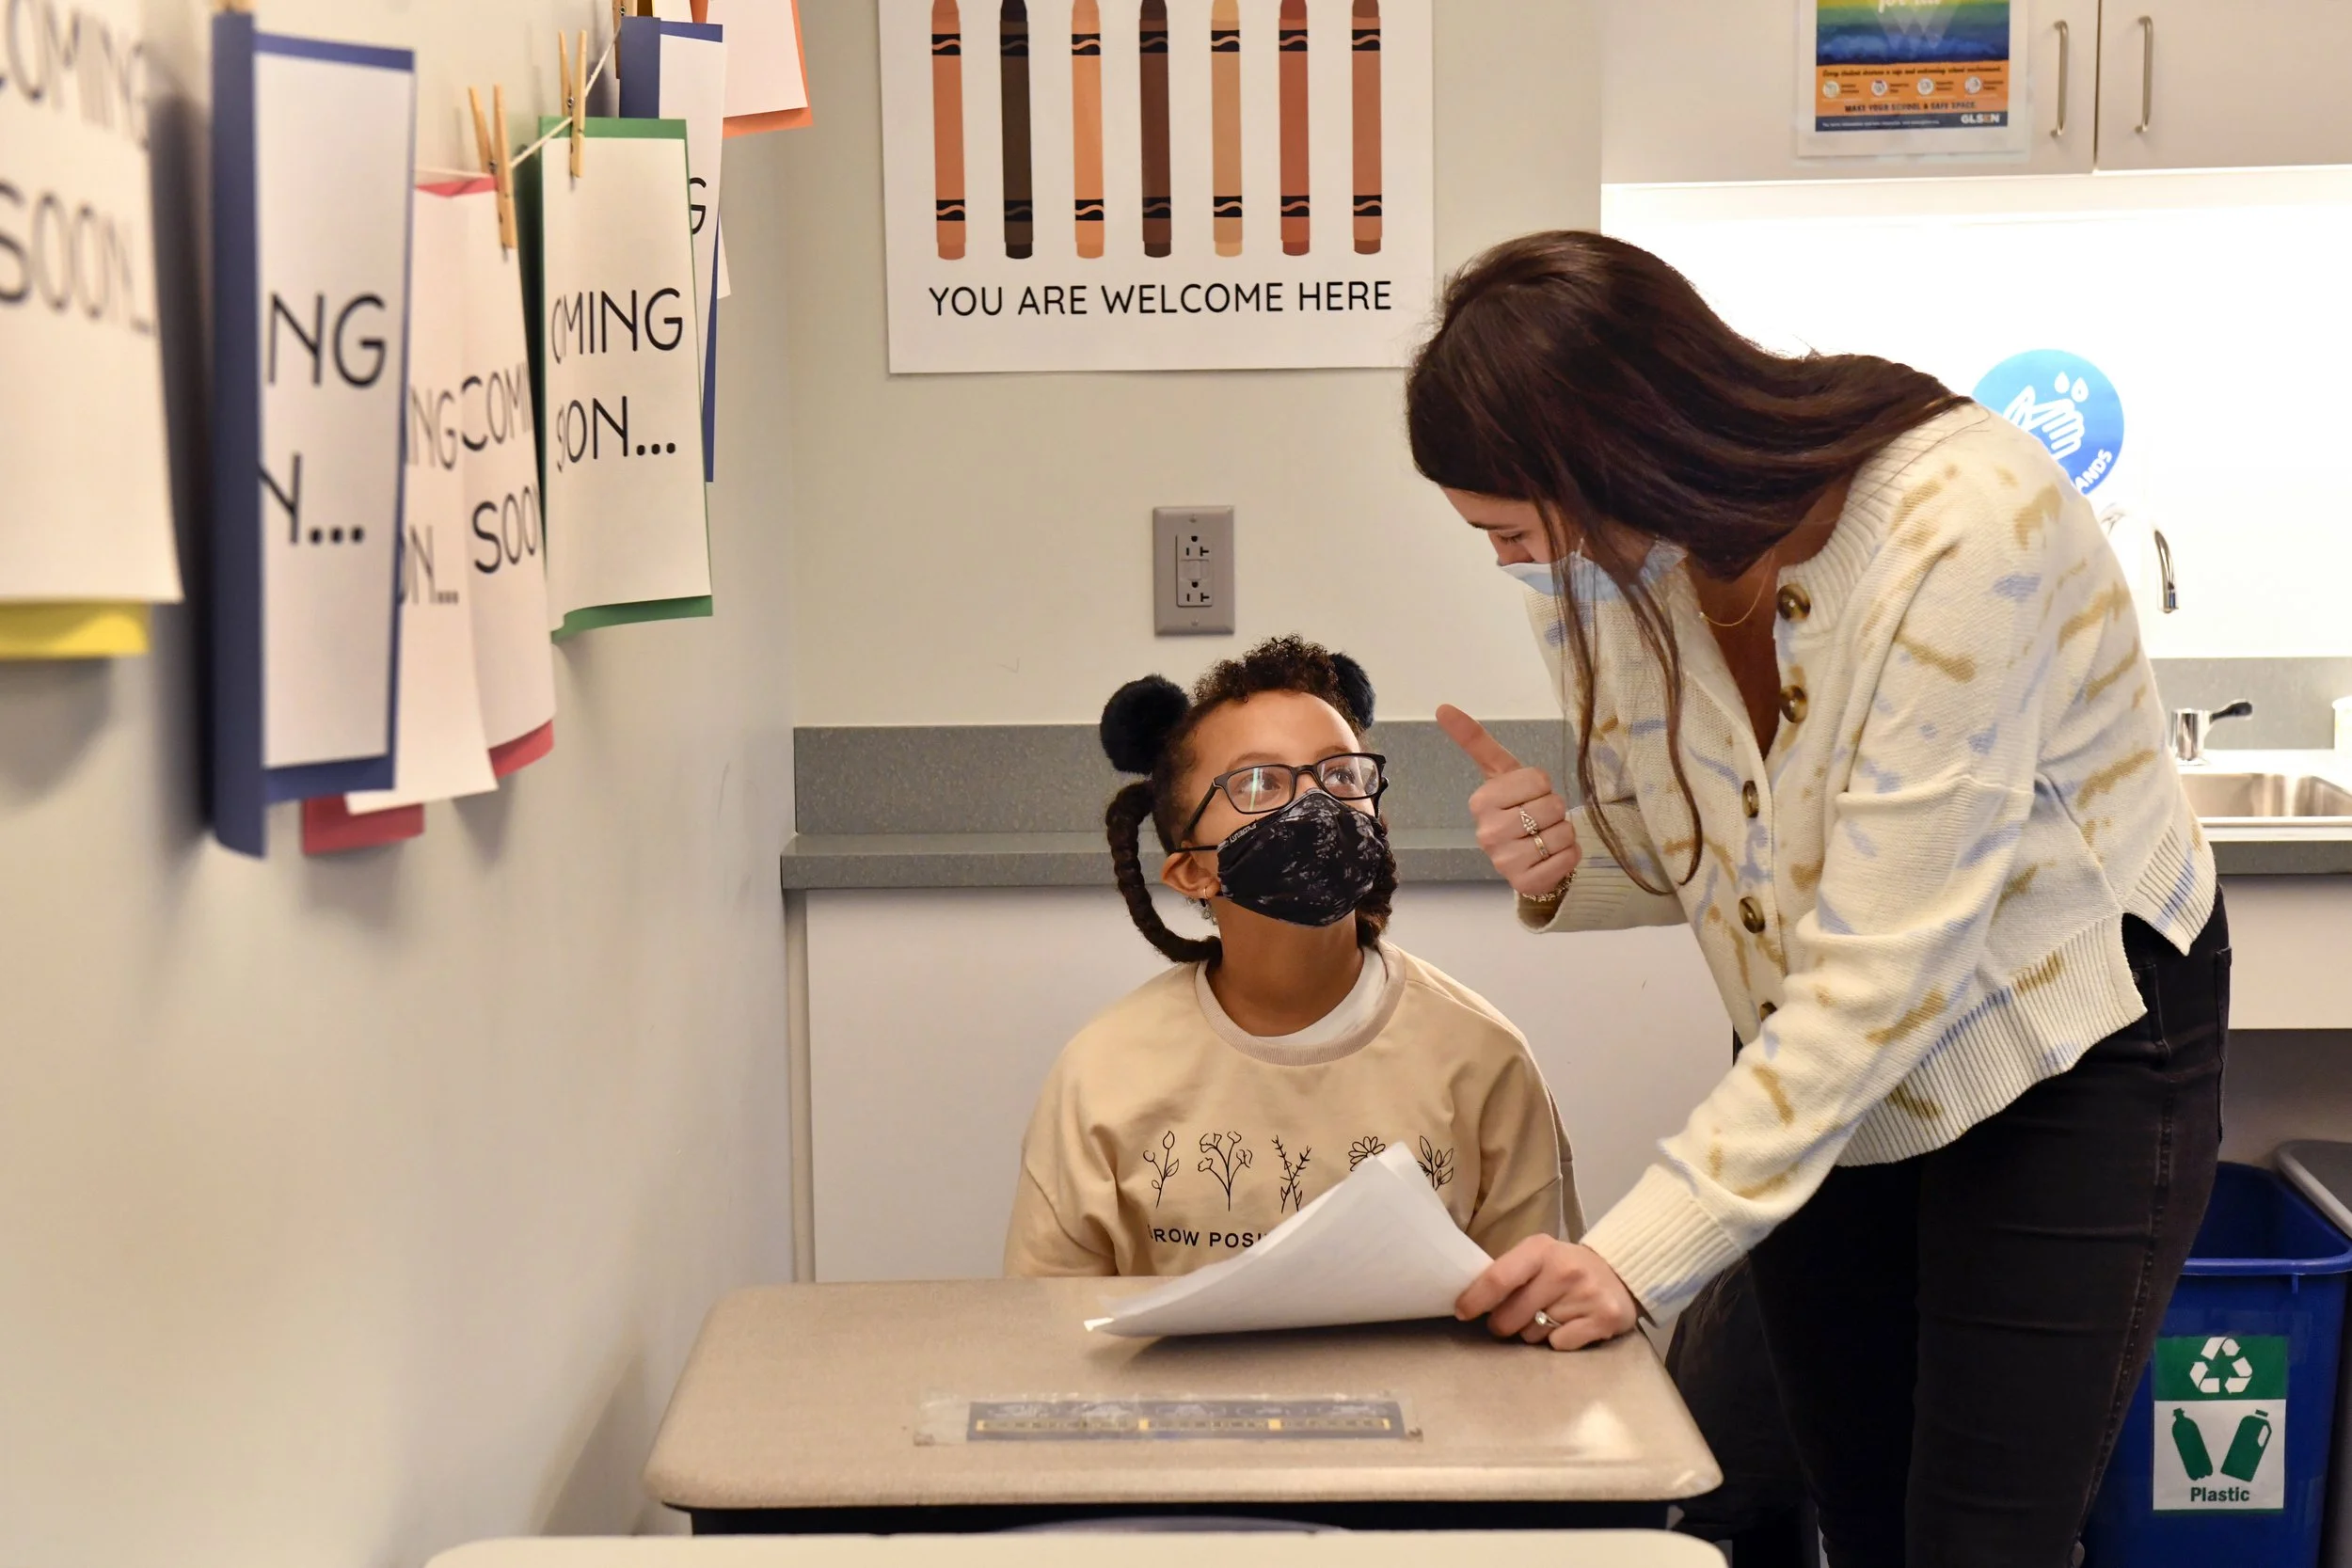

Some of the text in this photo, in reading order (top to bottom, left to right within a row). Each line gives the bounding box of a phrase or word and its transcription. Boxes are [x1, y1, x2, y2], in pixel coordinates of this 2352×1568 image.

[1961, 113, 2000, 124] GLSEN
[929, 280, 1392, 316] YOU ARE WELCOME HERE
[1148, 1224, 1200, 1247] ROW
[2190, 1486, 2250, 1502] Plastic
